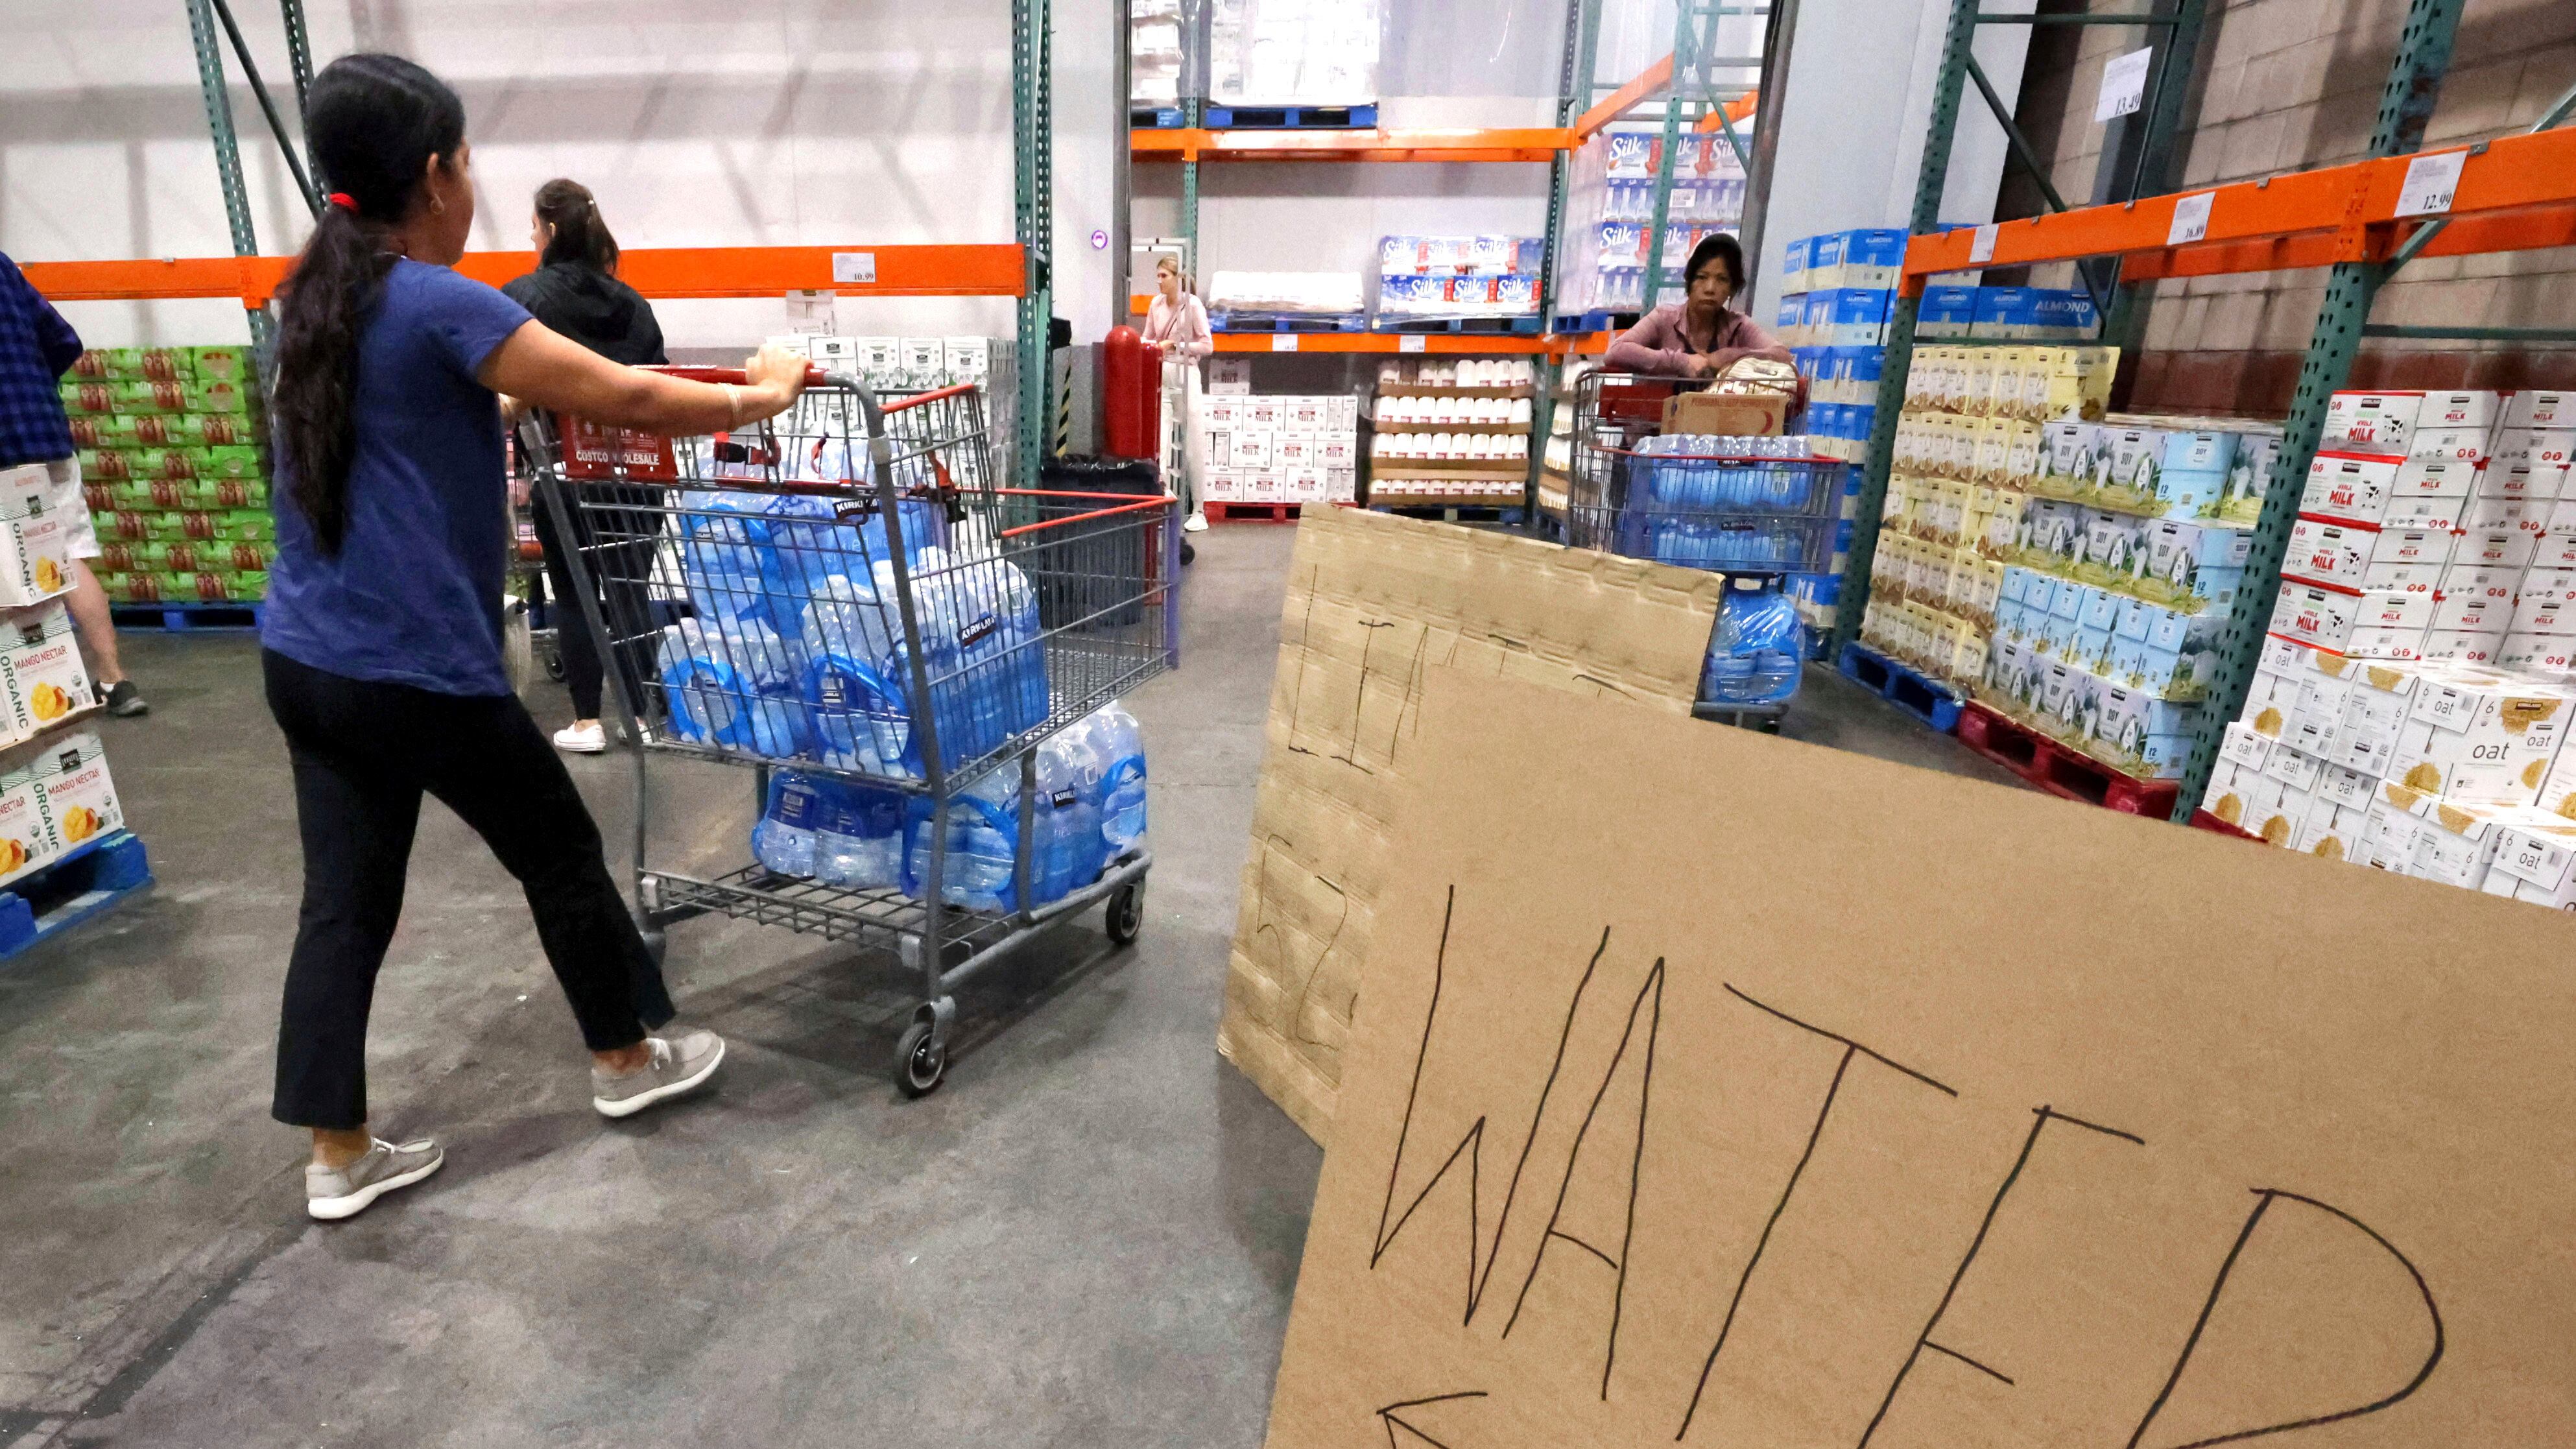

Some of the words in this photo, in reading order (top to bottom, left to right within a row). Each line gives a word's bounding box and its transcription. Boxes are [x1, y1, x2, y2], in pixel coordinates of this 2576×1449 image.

[2116, 93, 2141, 115] 13.49
[1609, 136, 1642, 160] Silk
[1676, 137, 1693, 155] lk
[2423, 192, 2452, 210] 12.99
[1600, 226, 1634, 249] Silk
[1664, 226, 1685, 245] ilk
[1383, 239, 1412, 261] Silk
[854, 272, 874, 281] 10.99
[1409, 278, 1438, 298] Silk
[1453, 278, 1481, 298] Silk
[1497, 278, 1525, 299] Silk
[2034, 300, 2090, 313] ALMOND
[2347, 427, 2376, 441] MILK
[576, 450, 608, 462] COSTCO
[2121, 452, 2133, 465] SOY
[2160, 485, 2169, 495] 12
[2329, 490, 2355, 506] MILK
[2157, 544, 2170, 557] SOY
[13, 523, 36, 597] ORGANIC
[2310, 555, 2336, 571] MILK
[2296, 616, 2320, 632] MILK
[14, 654, 40, 671] MANGO
[40, 645, 68, 662] NECTAR
[1, 656, 29, 730] ORGANIC
[2341, 691, 2347, 702] 6
[2423, 684, 2430, 696] 6
[2396, 706, 2402, 718] 6
[2435, 701, 2455, 715] oat
[2485, 701, 2495, 714] 6
[2107, 708, 2119, 722] SOY
[2527, 735, 2551, 747] oat
[2148, 747, 2157, 756] 12
[2237, 743, 2252, 756] oat
[2472, 743, 2510, 760] oat
[2284, 761, 2299, 774] oat
[2328, 767, 2334, 778] 6
[48, 779, 75, 796] MANGO
[76, 768, 101, 785] NECTAR
[2338, 782, 2355, 796] oat
[0, 796, 25, 815] NECTAR
[34, 783, 59, 850] ORGANIC
[2411, 826, 2418, 838] 6
[2507, 834, 2514, 846] 6
[2466, 852, 2473, 864] 6
[2519, 852, 2542, 870] oat
